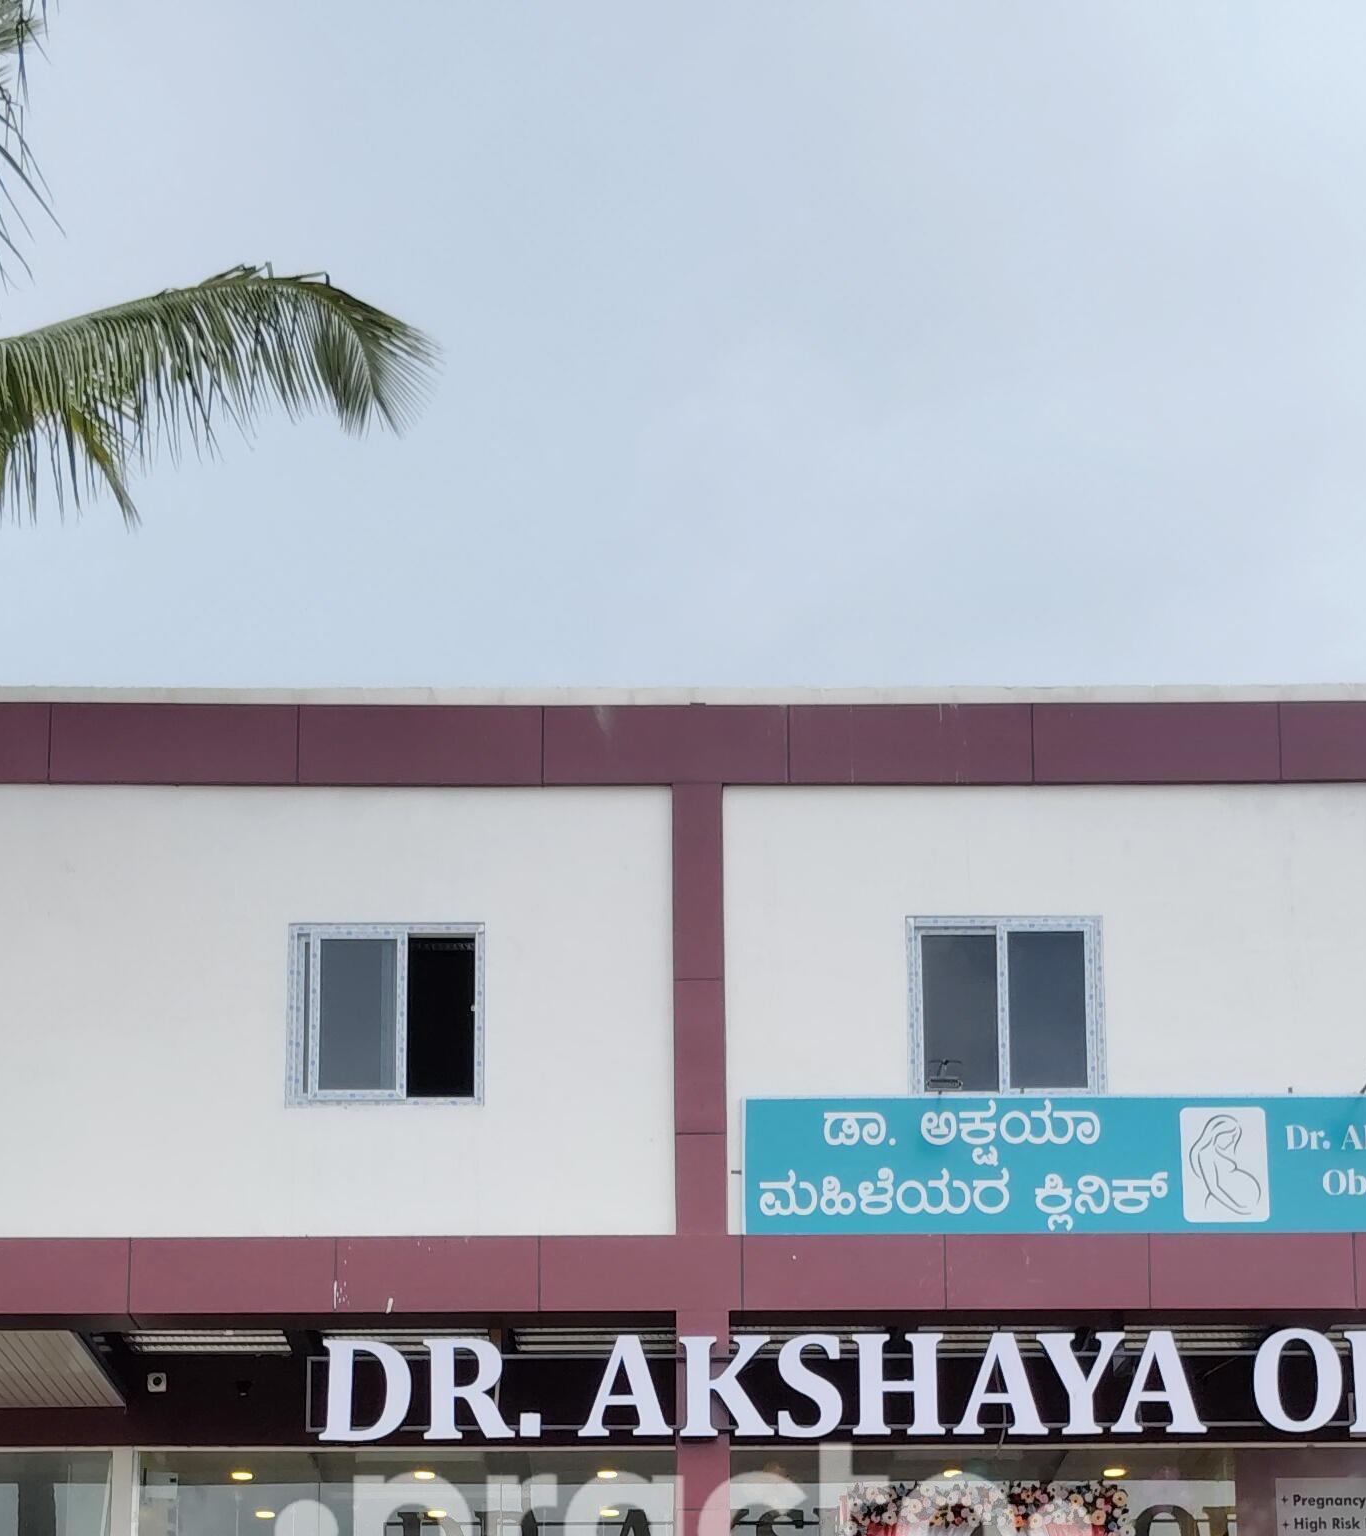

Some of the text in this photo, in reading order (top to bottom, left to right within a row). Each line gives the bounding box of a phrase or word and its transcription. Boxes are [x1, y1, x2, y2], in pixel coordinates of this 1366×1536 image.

[823, 1099, 1101, 1167] ಡಾ. ಅಕ್ಷಯಾ
[1285, 1124, 1331, 1150] Dr.
[759, 1167, 1010, 1216] ಮಹಿಳೆಯರ
[318, 1337, 541, 1442] DR.
[577, 1329, 1208, 1439] AKSHAYA
[1292, 1494, 1366, 1509] Pregnancy
[1294, 1517, 1327, 1532] High
[1332, 1517, 1360, 1529] Risk
